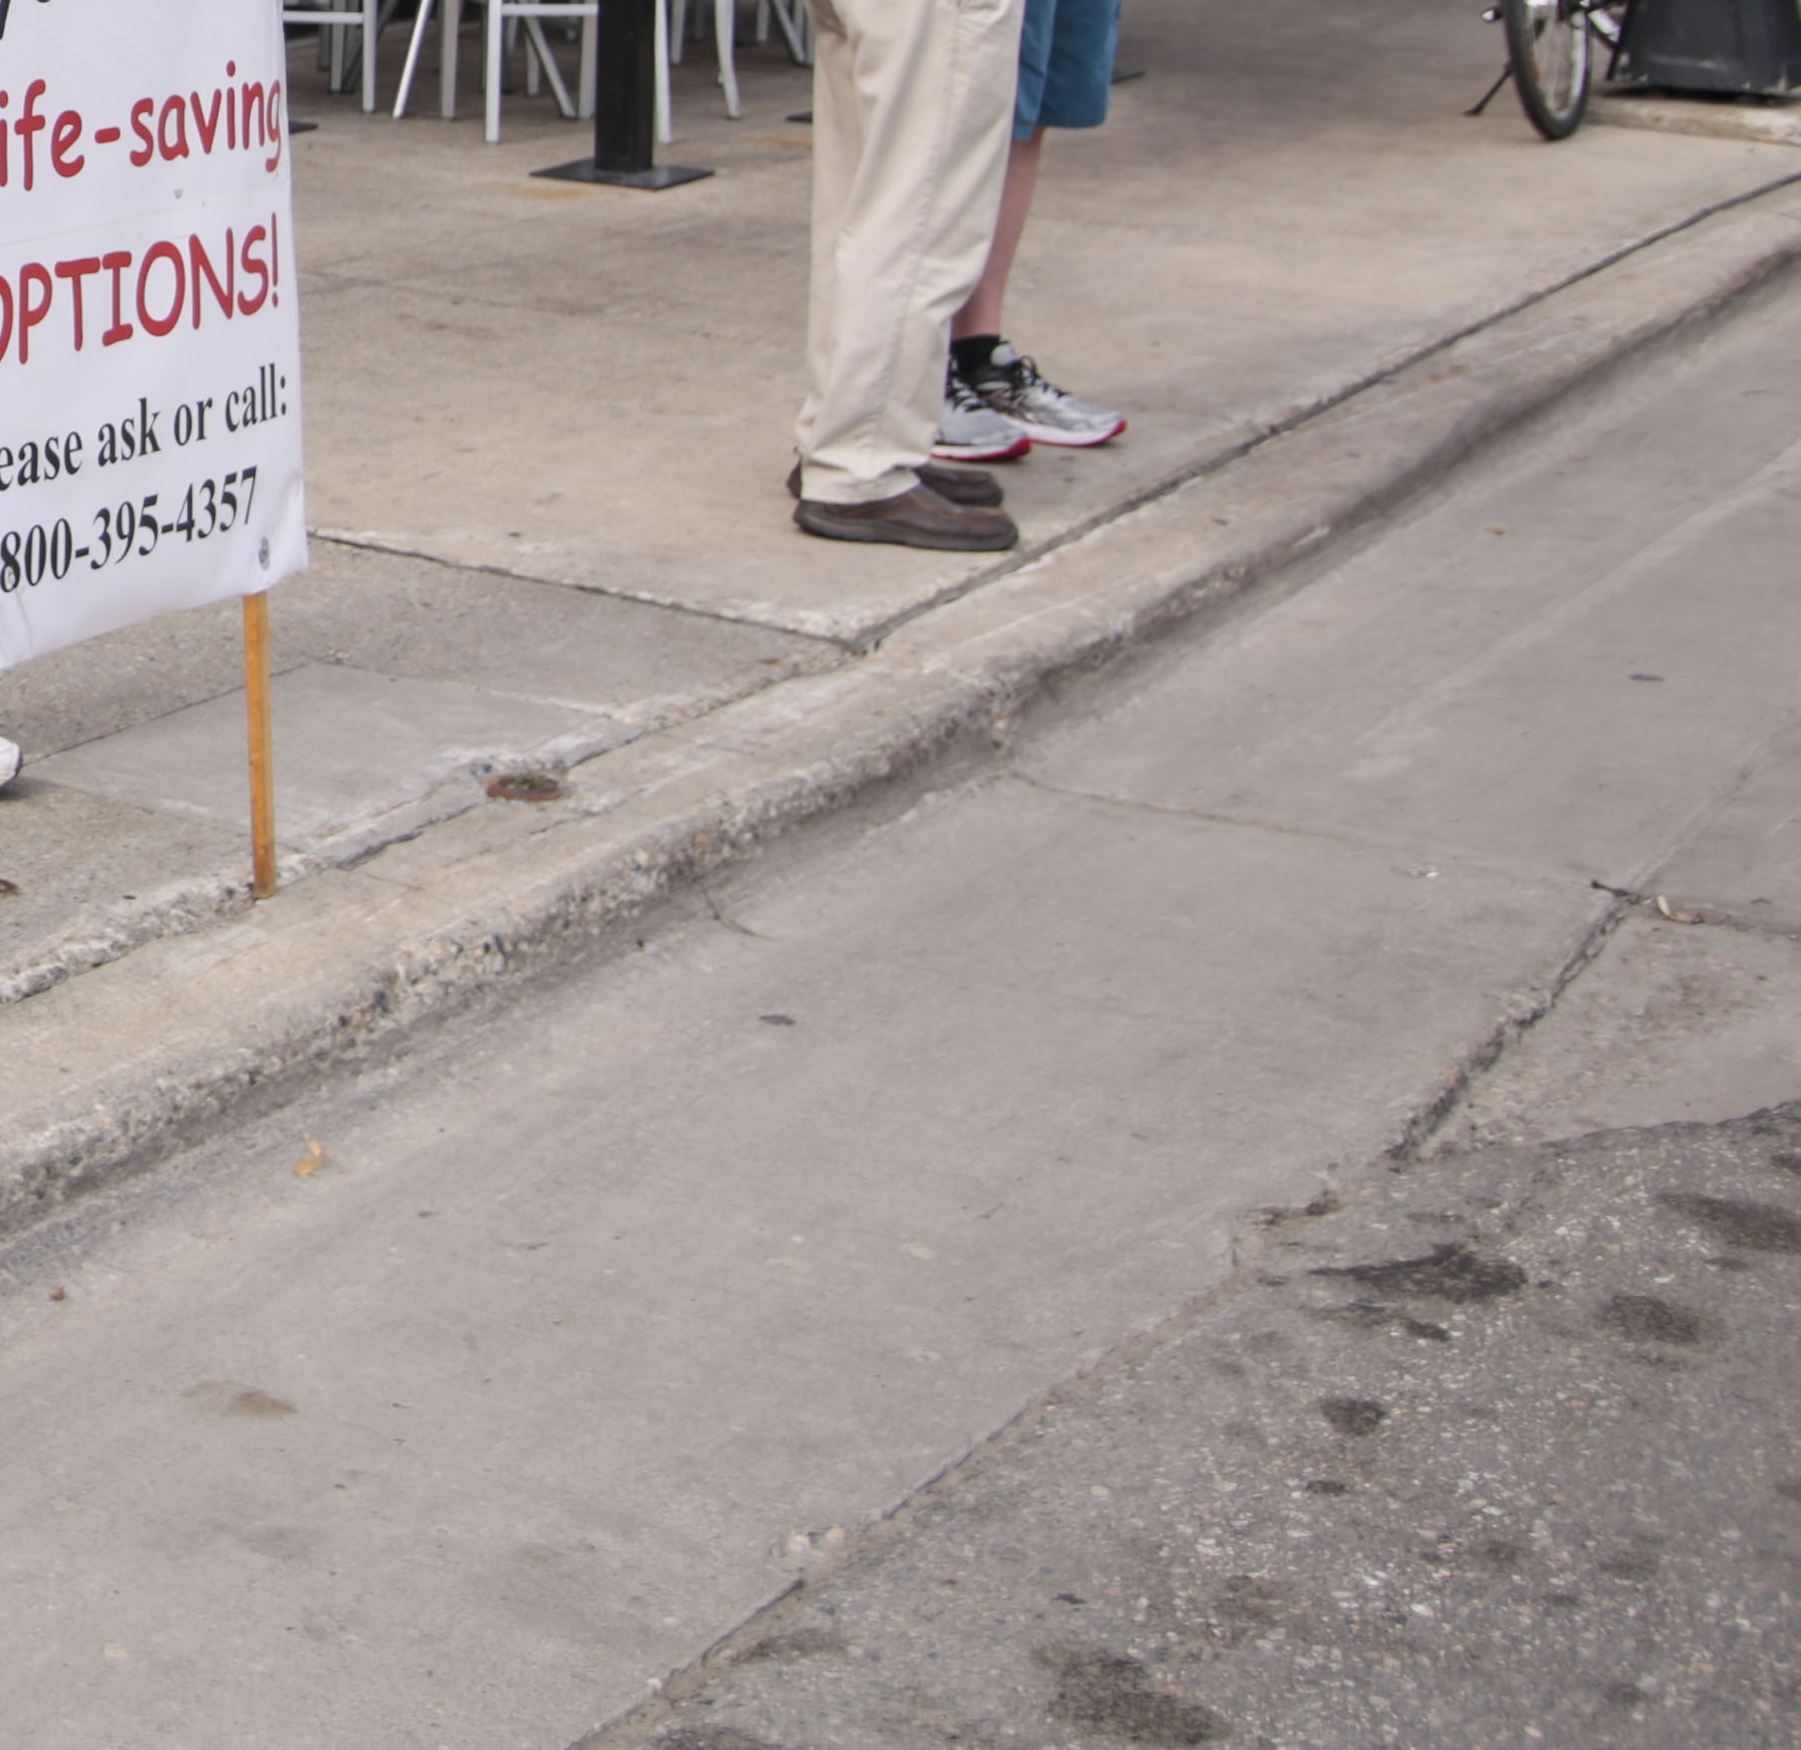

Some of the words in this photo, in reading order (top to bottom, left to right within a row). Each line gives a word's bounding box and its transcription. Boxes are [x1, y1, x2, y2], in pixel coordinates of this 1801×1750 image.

[96, 396, 162, 468] ask
[173, 396, 214, 447] or
[224, 361, 288, 433] call:
